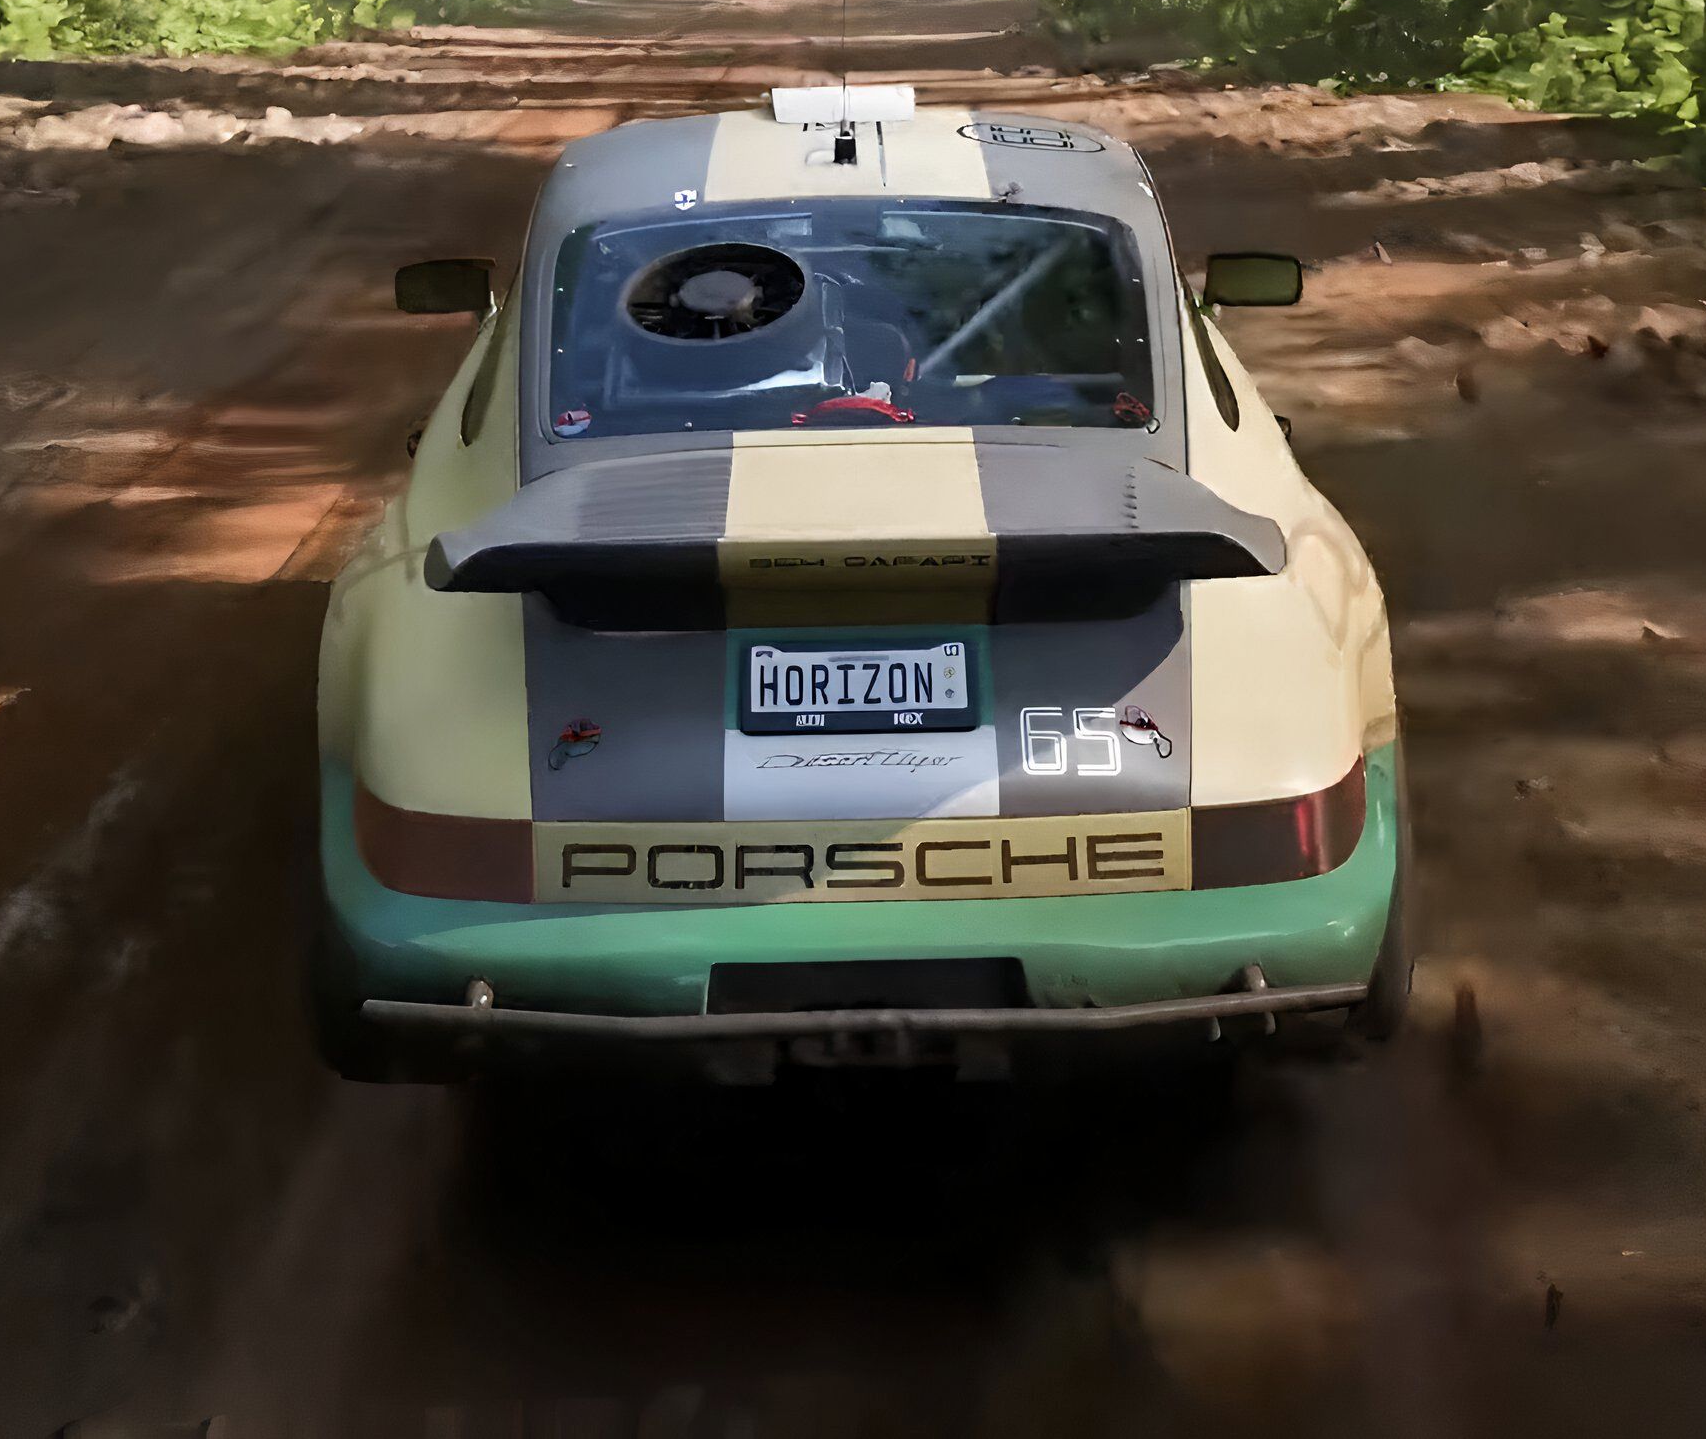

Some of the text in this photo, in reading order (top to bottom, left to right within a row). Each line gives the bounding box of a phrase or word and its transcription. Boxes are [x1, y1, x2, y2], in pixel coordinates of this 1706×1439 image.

[758, 661, 934, 708] HORIZON
[1019, 706, 1122, 777] 65
[561, 831, 1165, 890] PORSCHE
